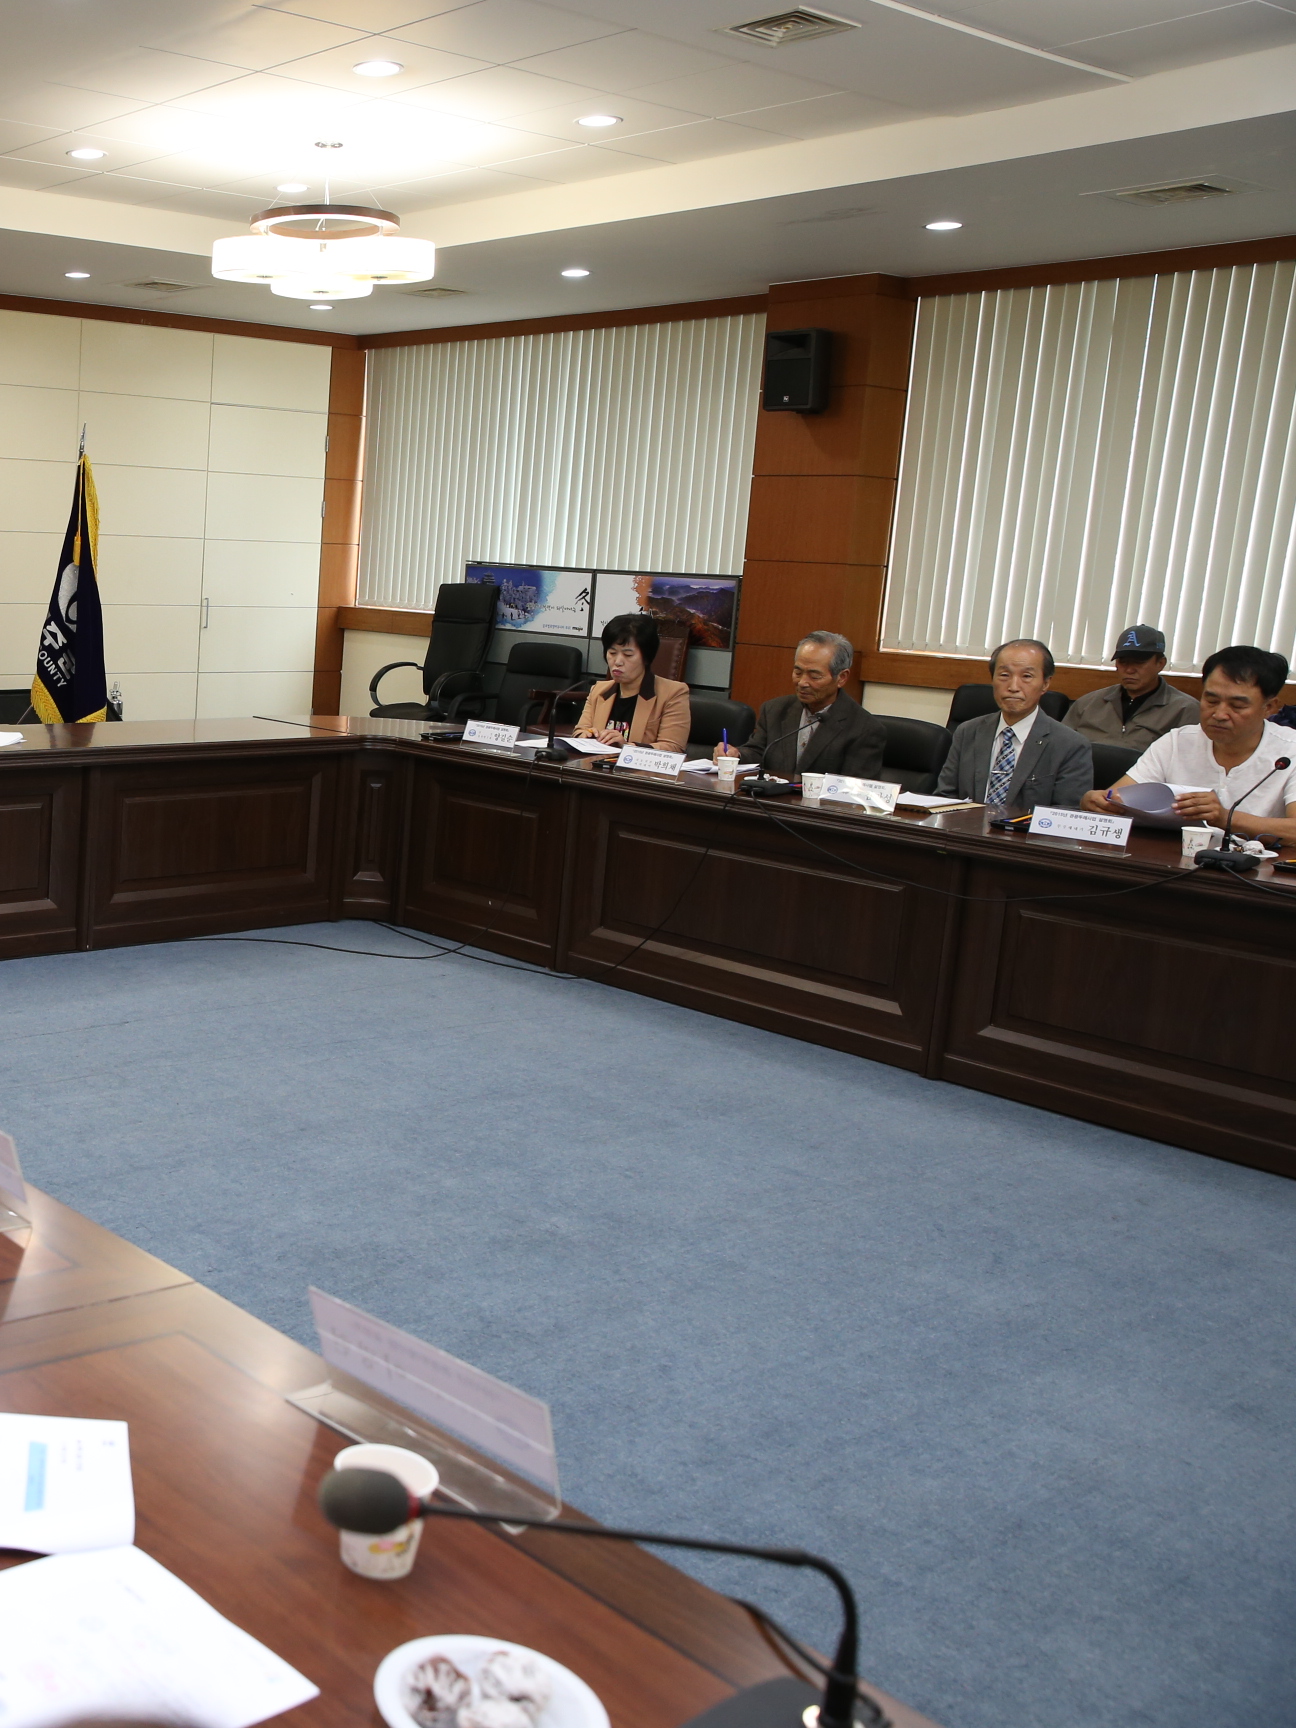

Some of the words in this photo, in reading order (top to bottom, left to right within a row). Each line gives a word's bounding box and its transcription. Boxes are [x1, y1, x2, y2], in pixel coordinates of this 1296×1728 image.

[1123, 630, 1141, 647] A
[39, 647, 67, 687] OUNTY
[1088, 824, 1123, 840] 김규생
